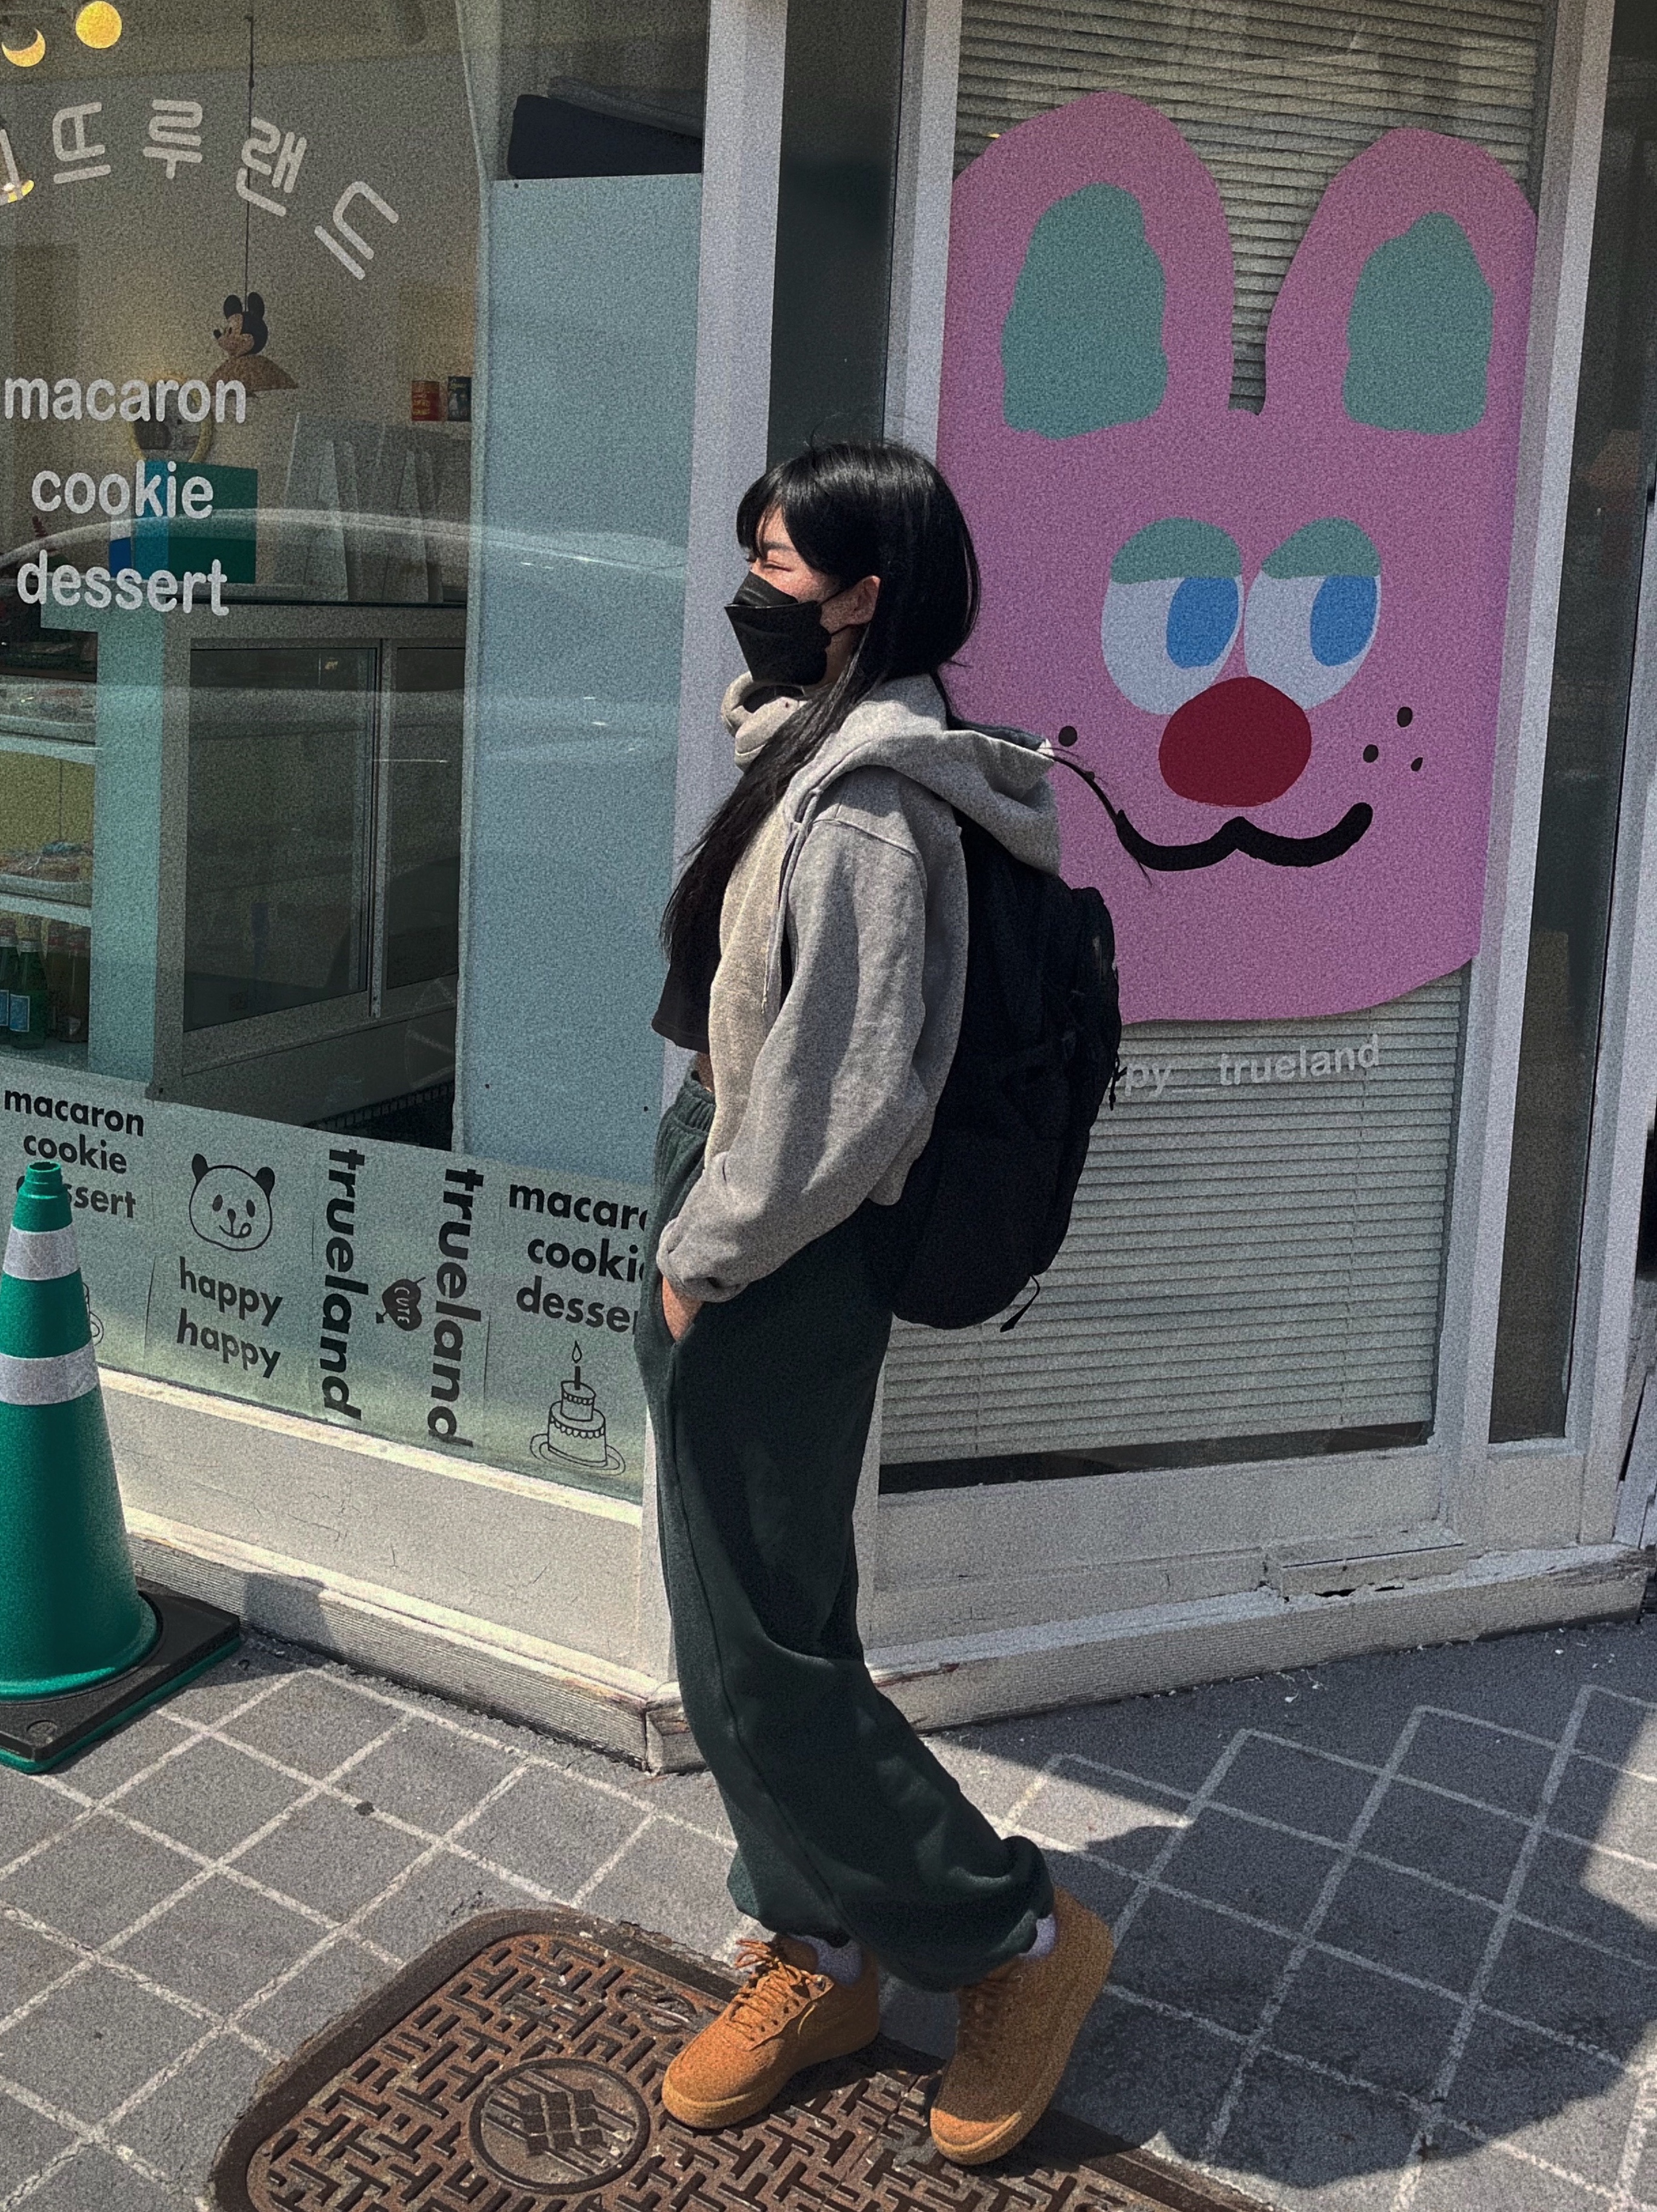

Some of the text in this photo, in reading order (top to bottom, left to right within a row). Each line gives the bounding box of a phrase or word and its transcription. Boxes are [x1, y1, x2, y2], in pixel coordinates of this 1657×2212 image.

[0, 99, 399, 281] 트루랜드
[4, 378, 246, 423] macaron
[32, 461, 214, 519] cookie
[17, 550, 229, 616] dessert
[4, 1090, 144, 1136] macaron
[23, 1134, 127, 1174] cookie
[179, 1256, 283, 1327] happy
[319, 1148, 368, 1421] trueland
[527, 1238, 644, 1283] cooki
[394, 1286, 410, 1325] CUTE
[427, 1168, 484, 1447] trueland
[177, 1308, 281, 1379] happy
